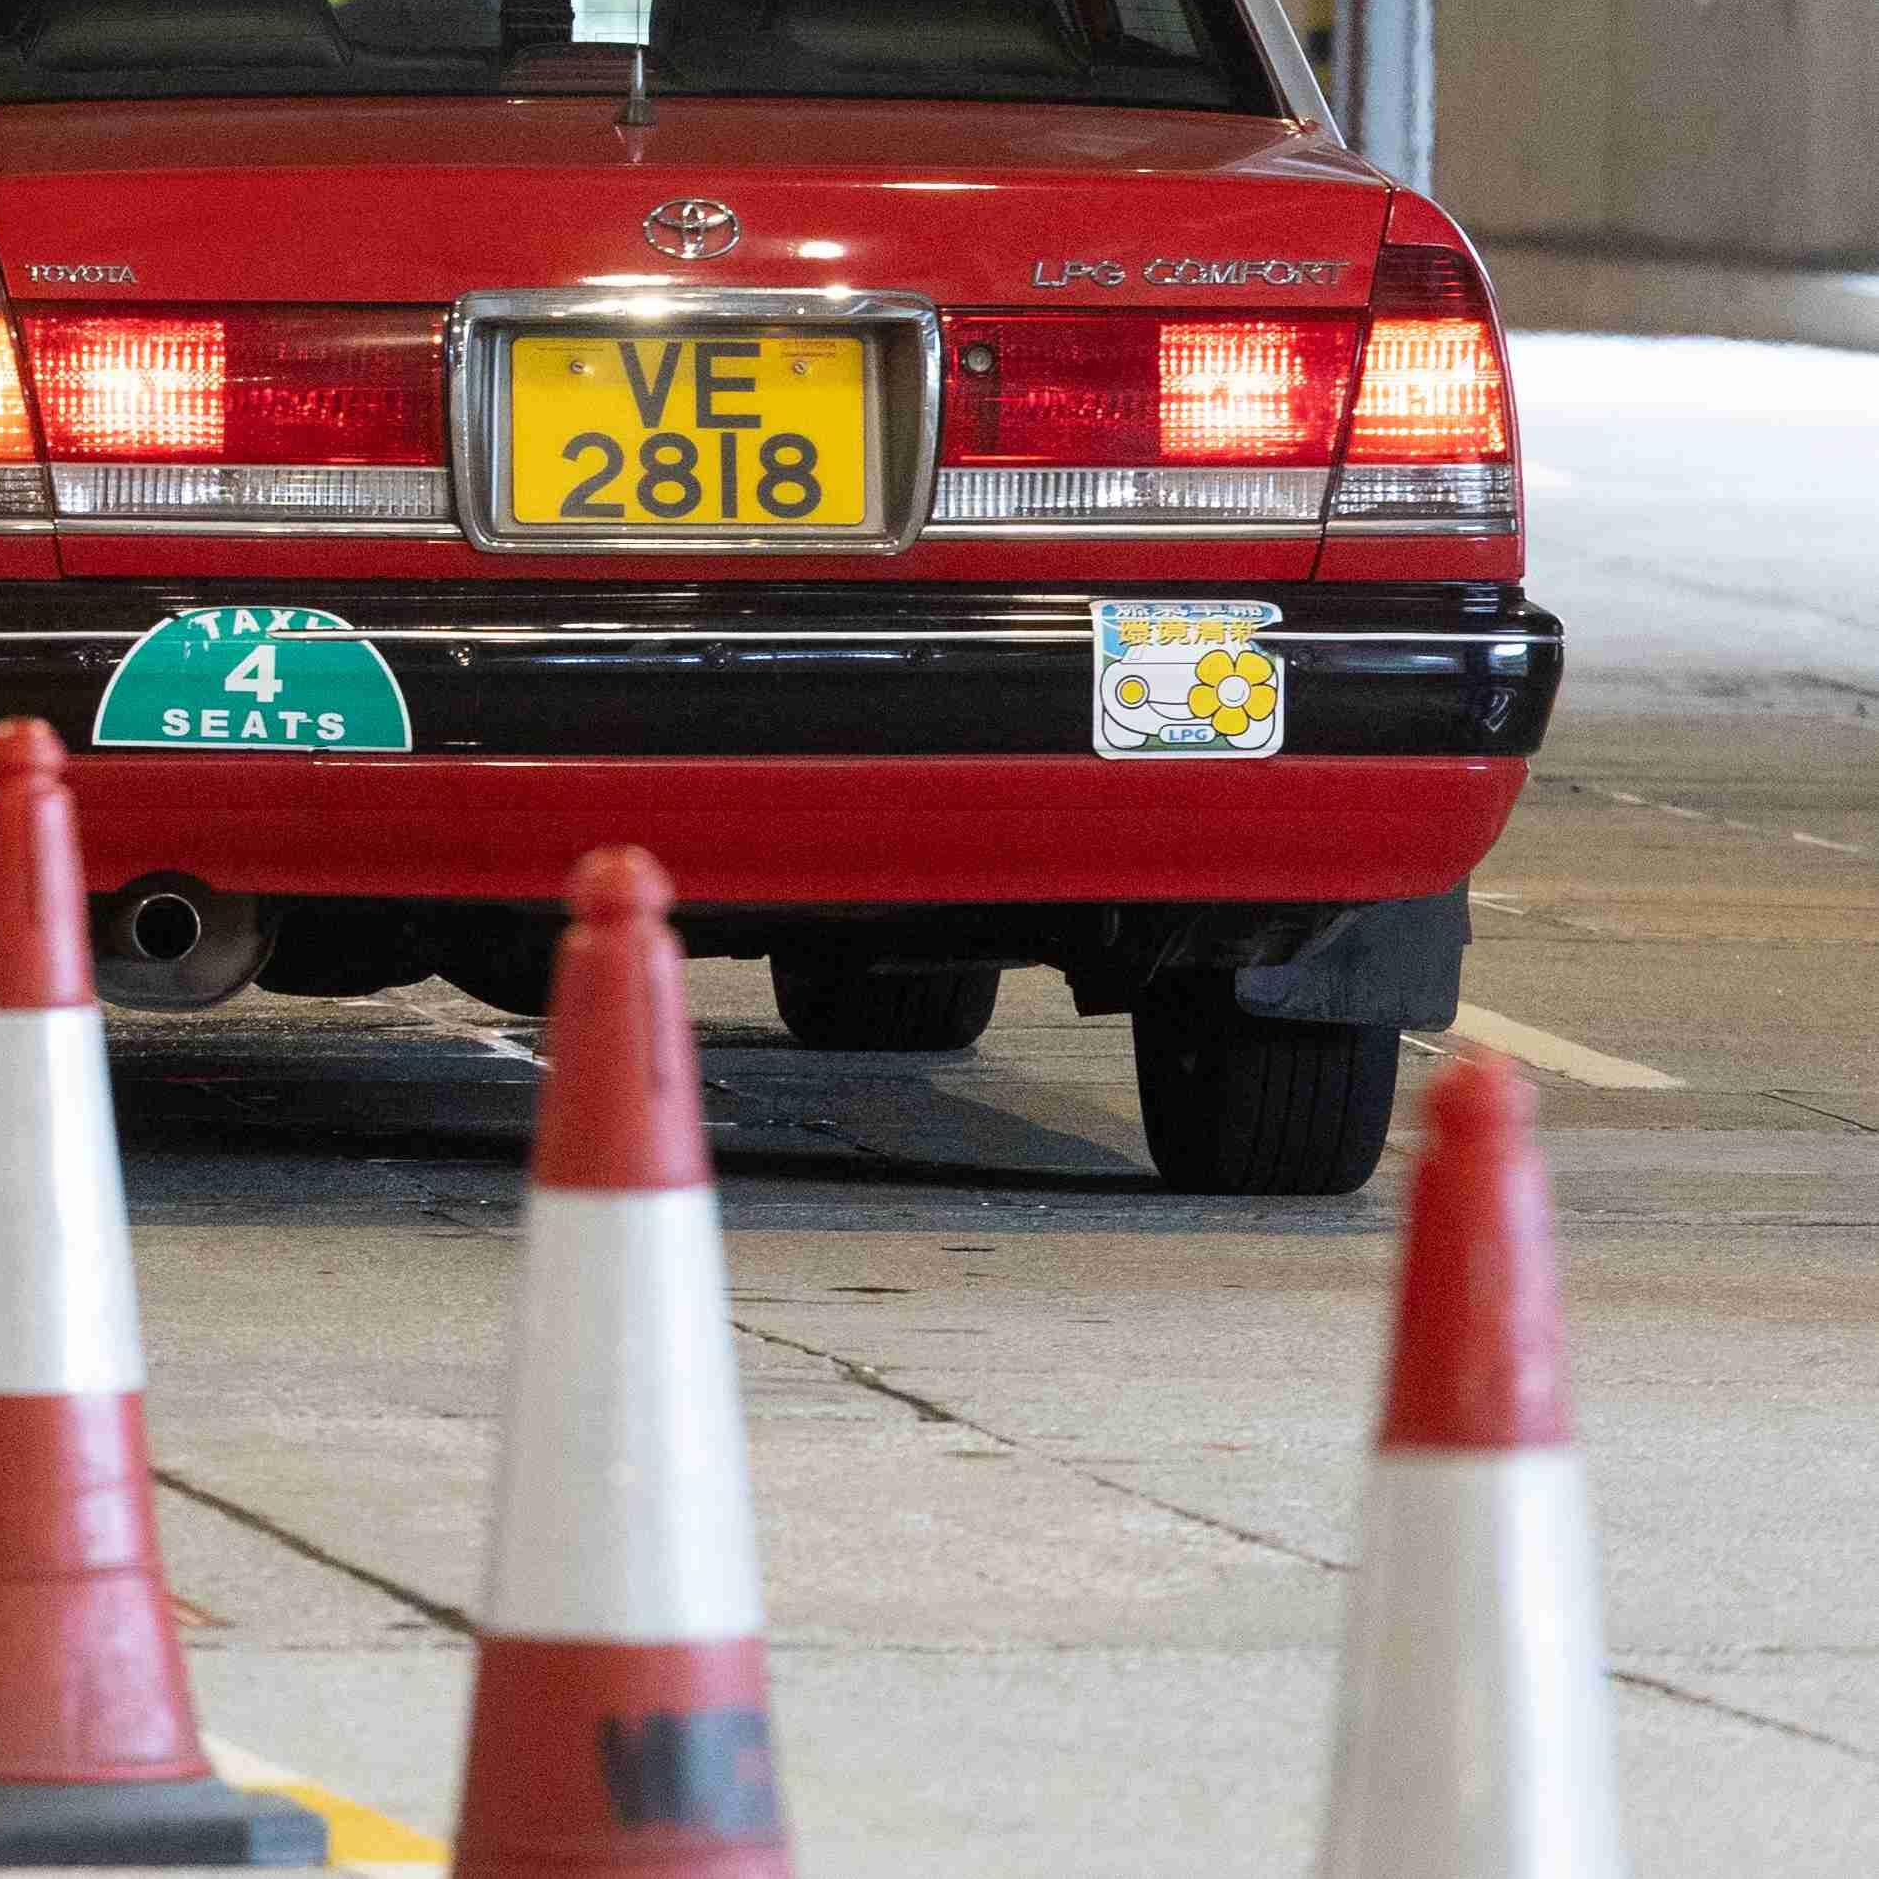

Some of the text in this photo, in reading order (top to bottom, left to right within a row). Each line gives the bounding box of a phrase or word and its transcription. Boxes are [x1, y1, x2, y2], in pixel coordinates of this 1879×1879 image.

[24, 264, 138, 283] TOYOTA
[1030, 258, 1351, 287] LPG COMFORT
[617, 341, 762, 429] VE
[560, 432, 822, 519] 2818
[224, 644, 283, 703] 4
[162, 709, 346, 740] SEATS
[1169, 728, 1208, 741] LPG
